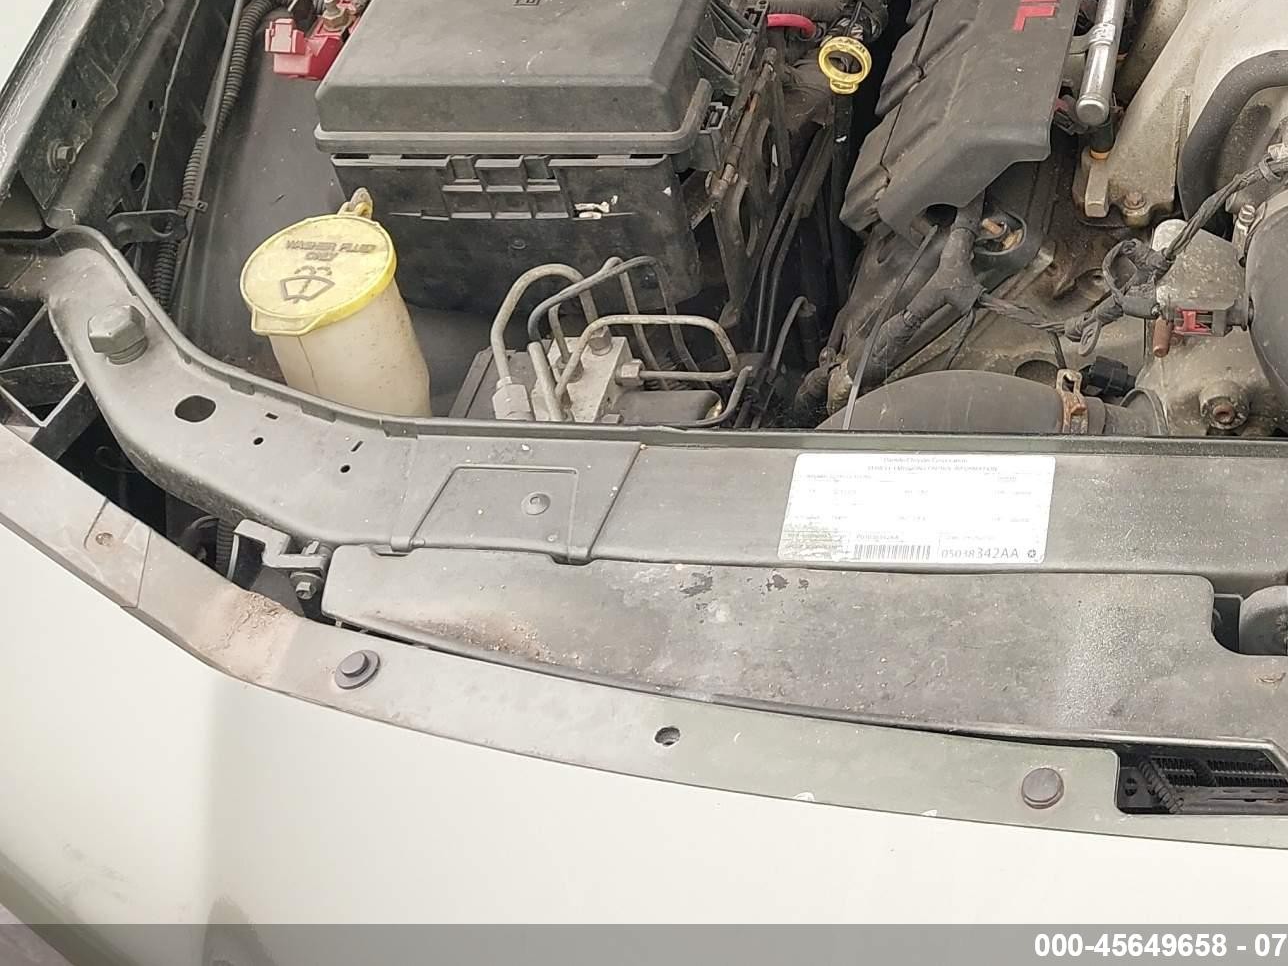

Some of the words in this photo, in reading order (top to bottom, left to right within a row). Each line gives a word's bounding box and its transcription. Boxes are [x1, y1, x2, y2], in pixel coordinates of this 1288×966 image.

[286, 240, 337, 252] WASHER
[338, 242, 377, 255] FLUID
[304, 251, 338, 262] ONLY
